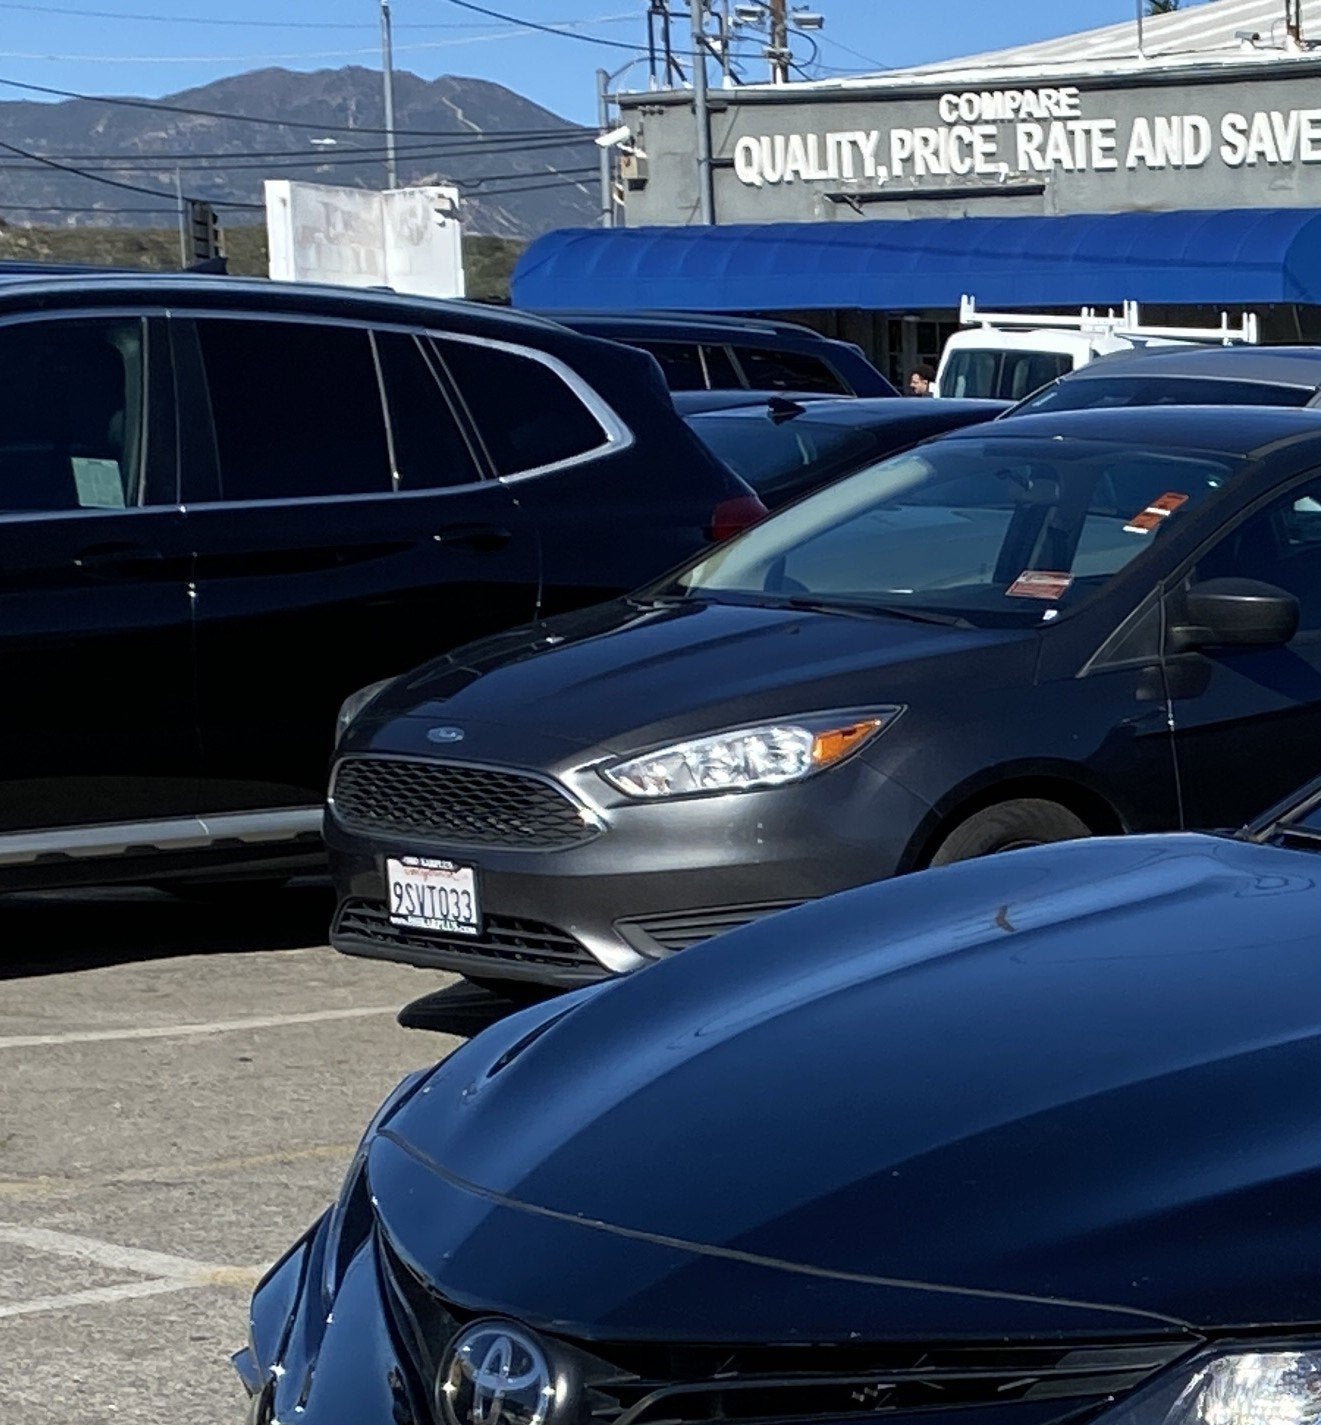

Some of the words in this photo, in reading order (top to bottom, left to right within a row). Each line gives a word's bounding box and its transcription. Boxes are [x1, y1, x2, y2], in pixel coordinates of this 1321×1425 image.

[938, 87, 1082, 123] COMPARE
[734, 130, 888, 188] QUALITY,
[890, 125, 1009, 183] PRICE,
[1016, 118, 1118, 172] RATE
[1126, 115, 1212, 170] AND
